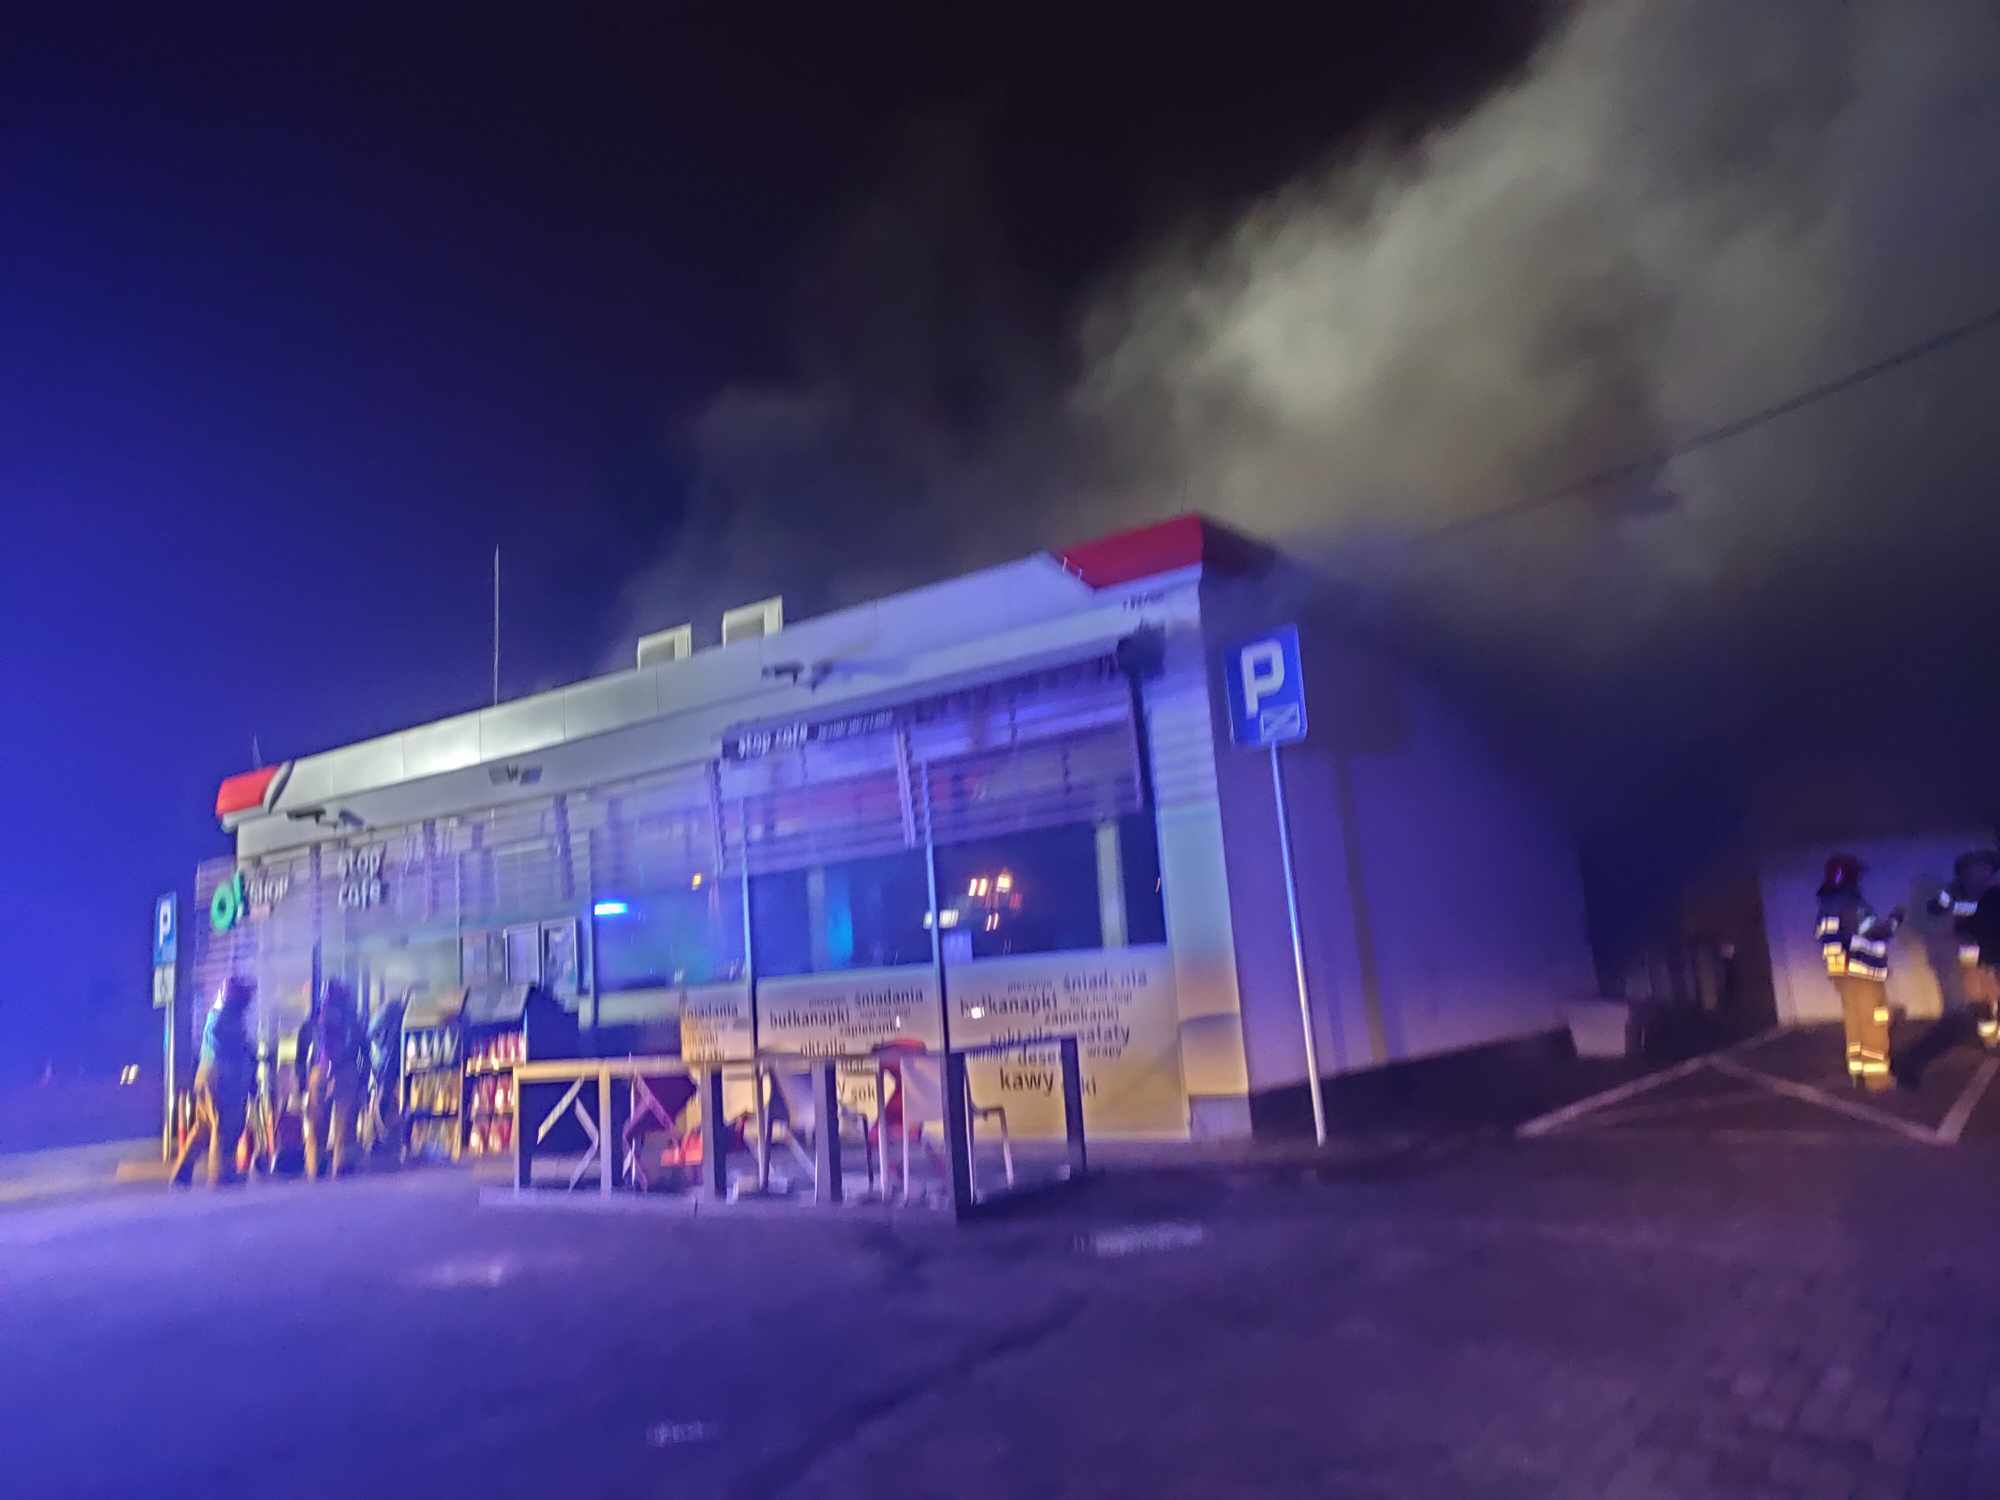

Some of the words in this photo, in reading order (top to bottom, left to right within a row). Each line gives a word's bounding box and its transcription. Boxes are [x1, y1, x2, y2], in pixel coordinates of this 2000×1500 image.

[1241, 640, 1285, 719] P
[159, 899, 172, 946] P
[1000, 1067, 1054, 1097] kawy
